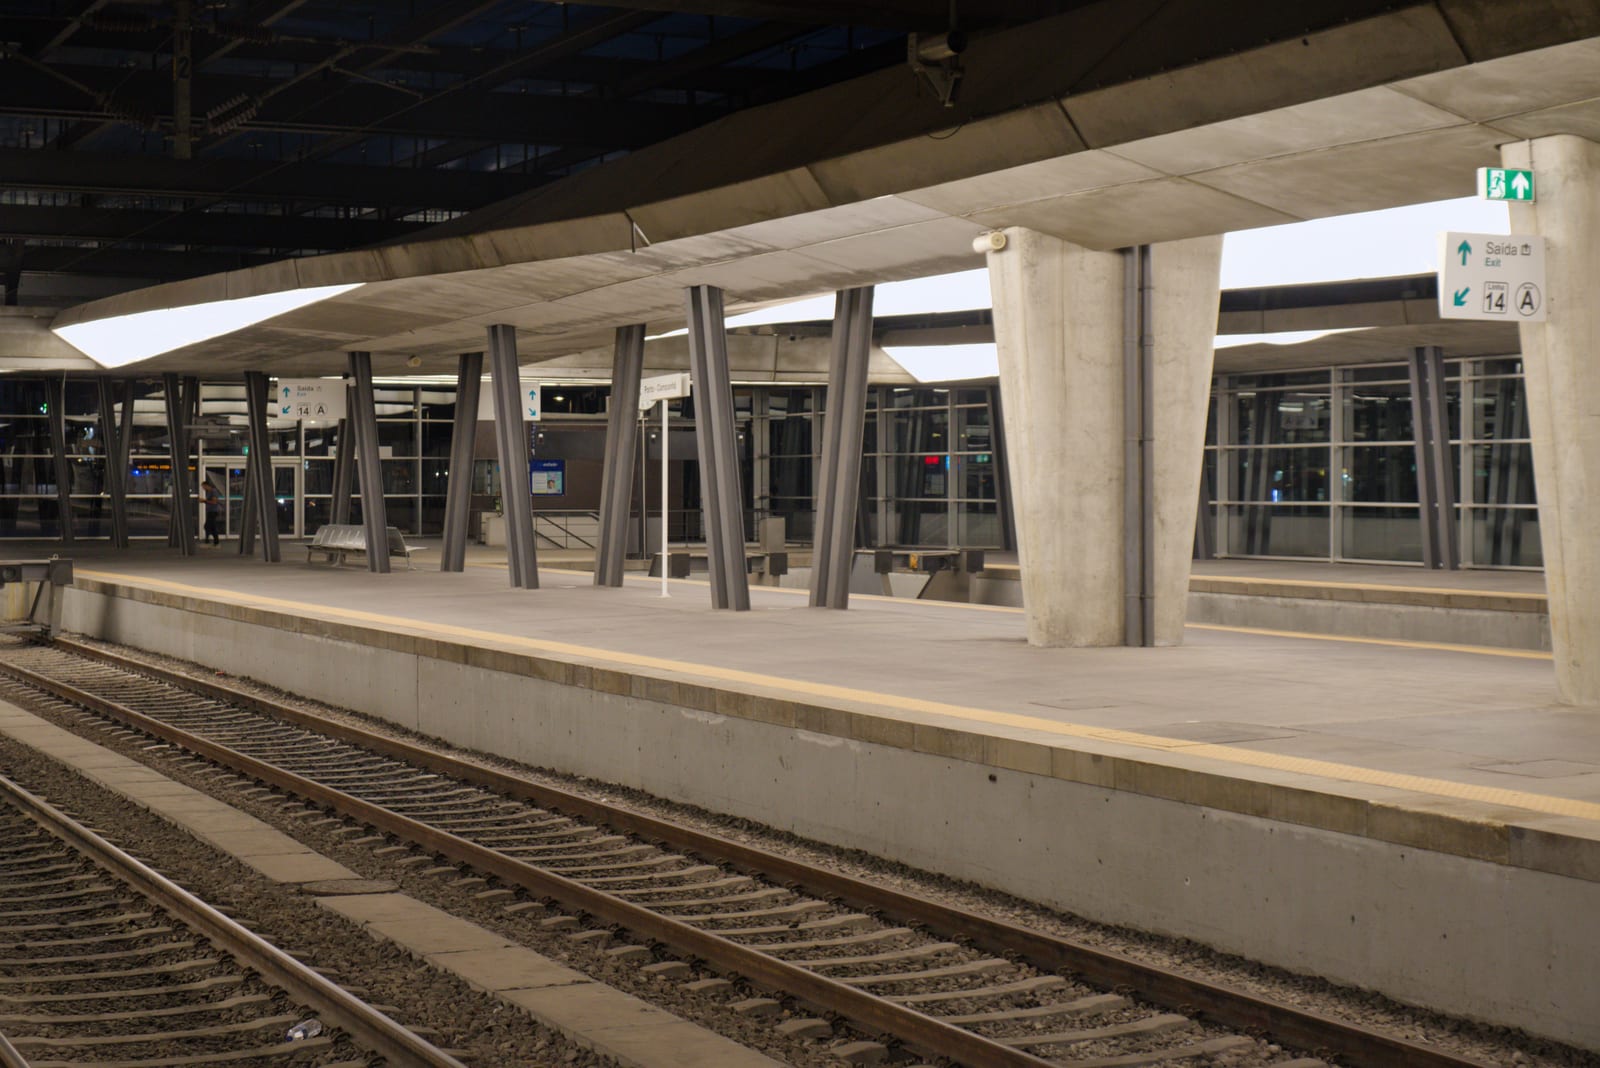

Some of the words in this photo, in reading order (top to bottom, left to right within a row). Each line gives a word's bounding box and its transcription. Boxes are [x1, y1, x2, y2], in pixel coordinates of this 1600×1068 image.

[179, 57, 189, 78] 2
[1486, 241, 1518, 256] Saída
[1485, 257, 1502, 266] Exit
[1486, 292, 1505, 311] 14
[1520, 290, 1534, 310] A
[298, 407, 309, 416] 14
[318, 405, 325, 414] A
